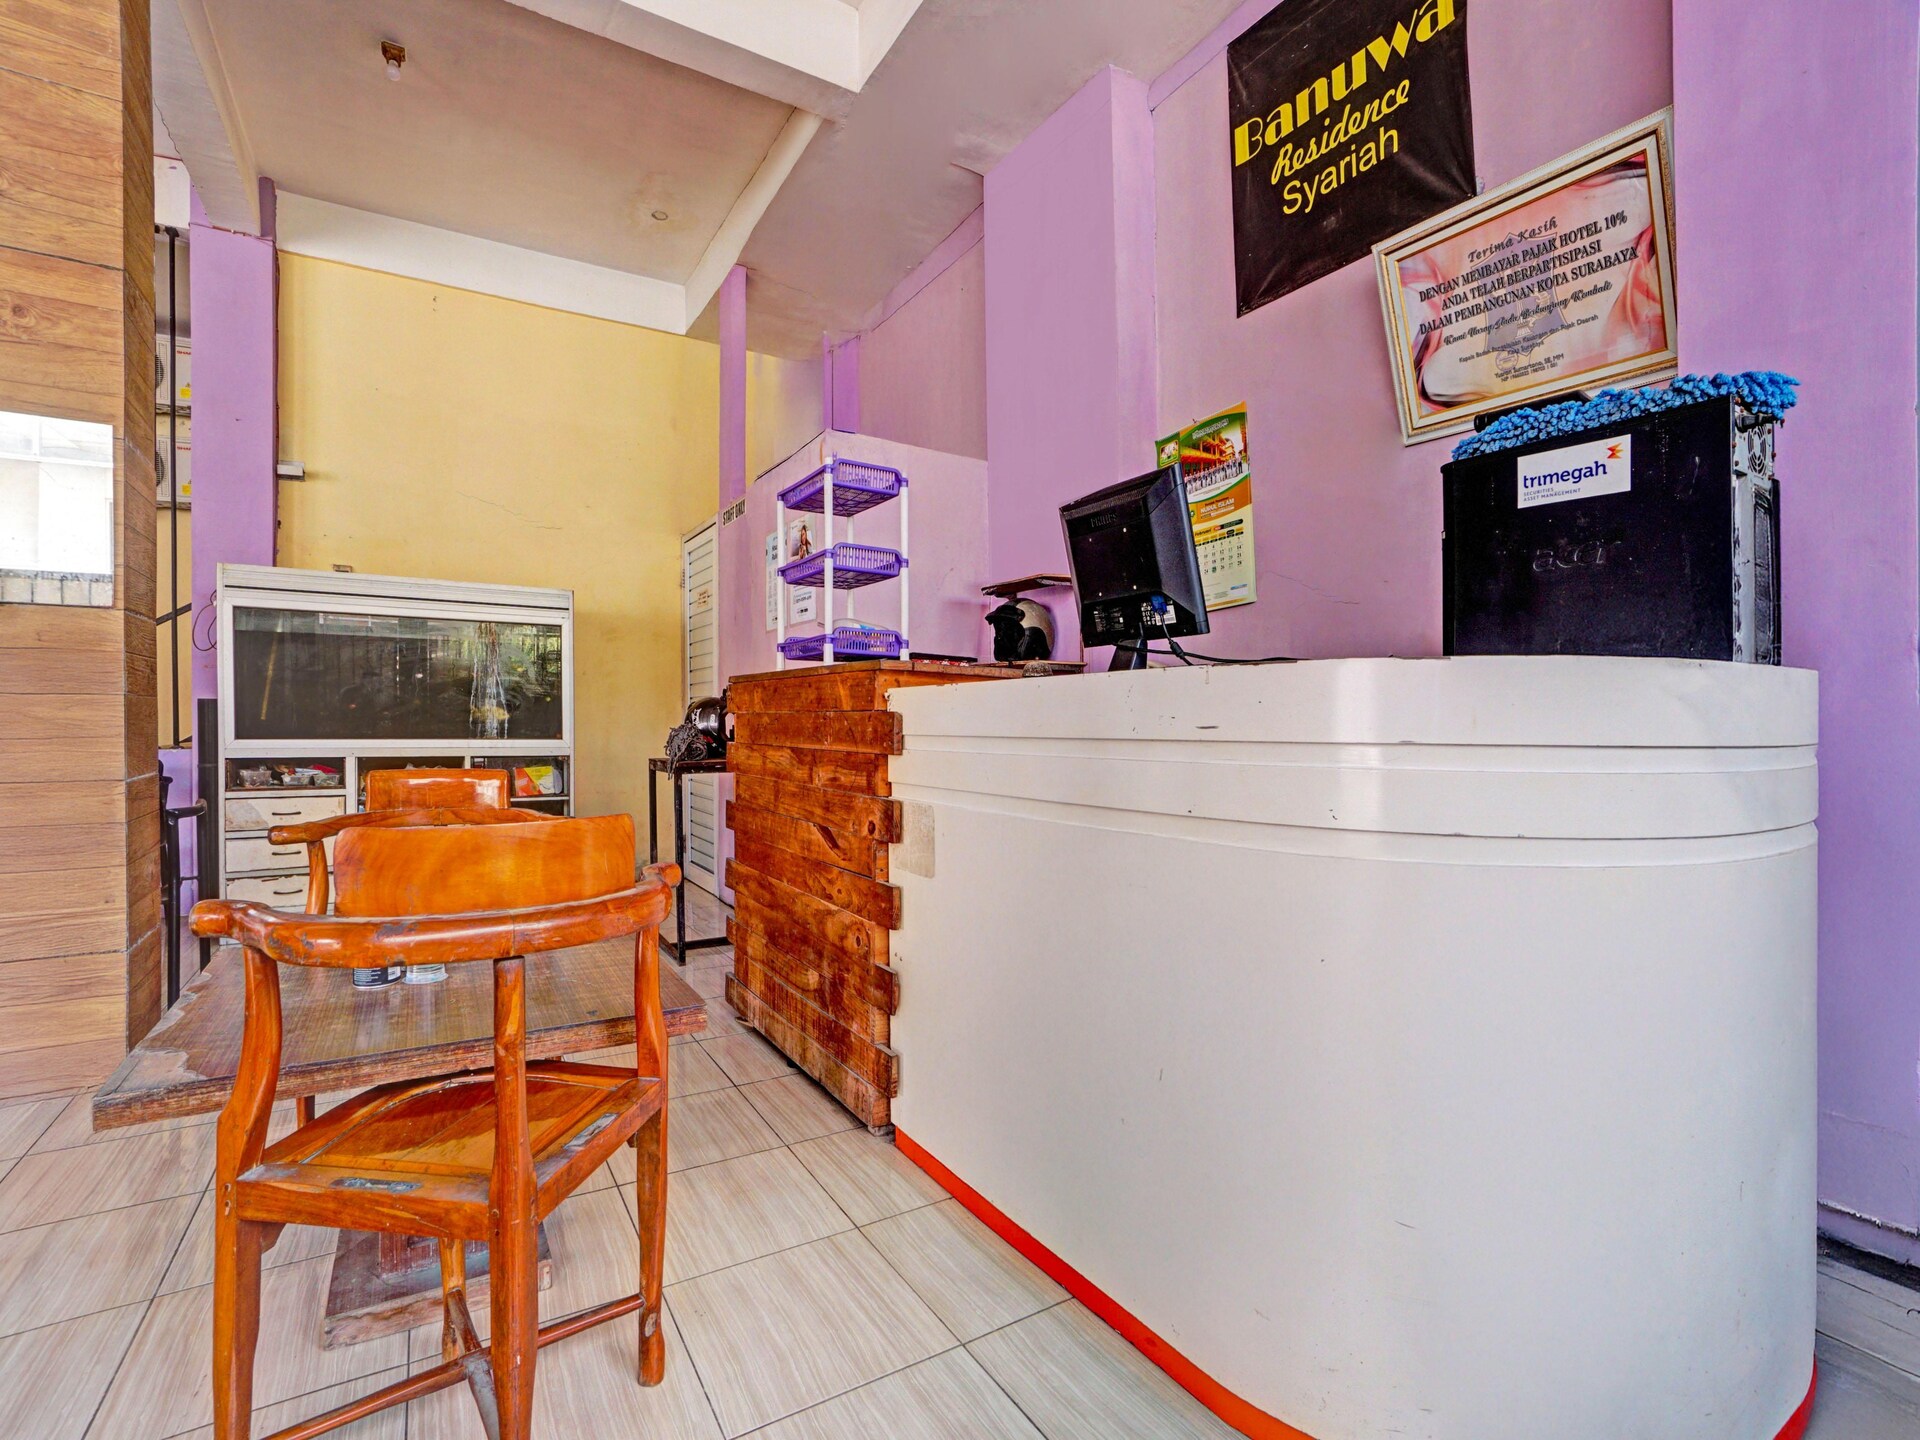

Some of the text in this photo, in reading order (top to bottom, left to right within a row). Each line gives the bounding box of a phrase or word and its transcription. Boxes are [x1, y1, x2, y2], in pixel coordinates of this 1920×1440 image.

[1234, 0, 1456, 167] Banuwa
[1271, 79, 1411, 186] Residence
[1282, 126, 1400, 215] Syariah
[1419, 210, 1628, 303] DENGAN MEMBAYAR PAJAK HOTEL 10%
[1442, 239, 1603, 311] ANDA TELAH BERPARTISIPASI
[1468, 216, 1558, 263] Terima Kasih
[1419, 246, 1639, 335] DALAM PEMBANGUNAN KOTA SURABAYA
[1523, 460, 1607, 489] trimegah
[1523, 487, 1554, 497] SECURITIES
[1540, 488, 1581, 498] MANAGEMENT
